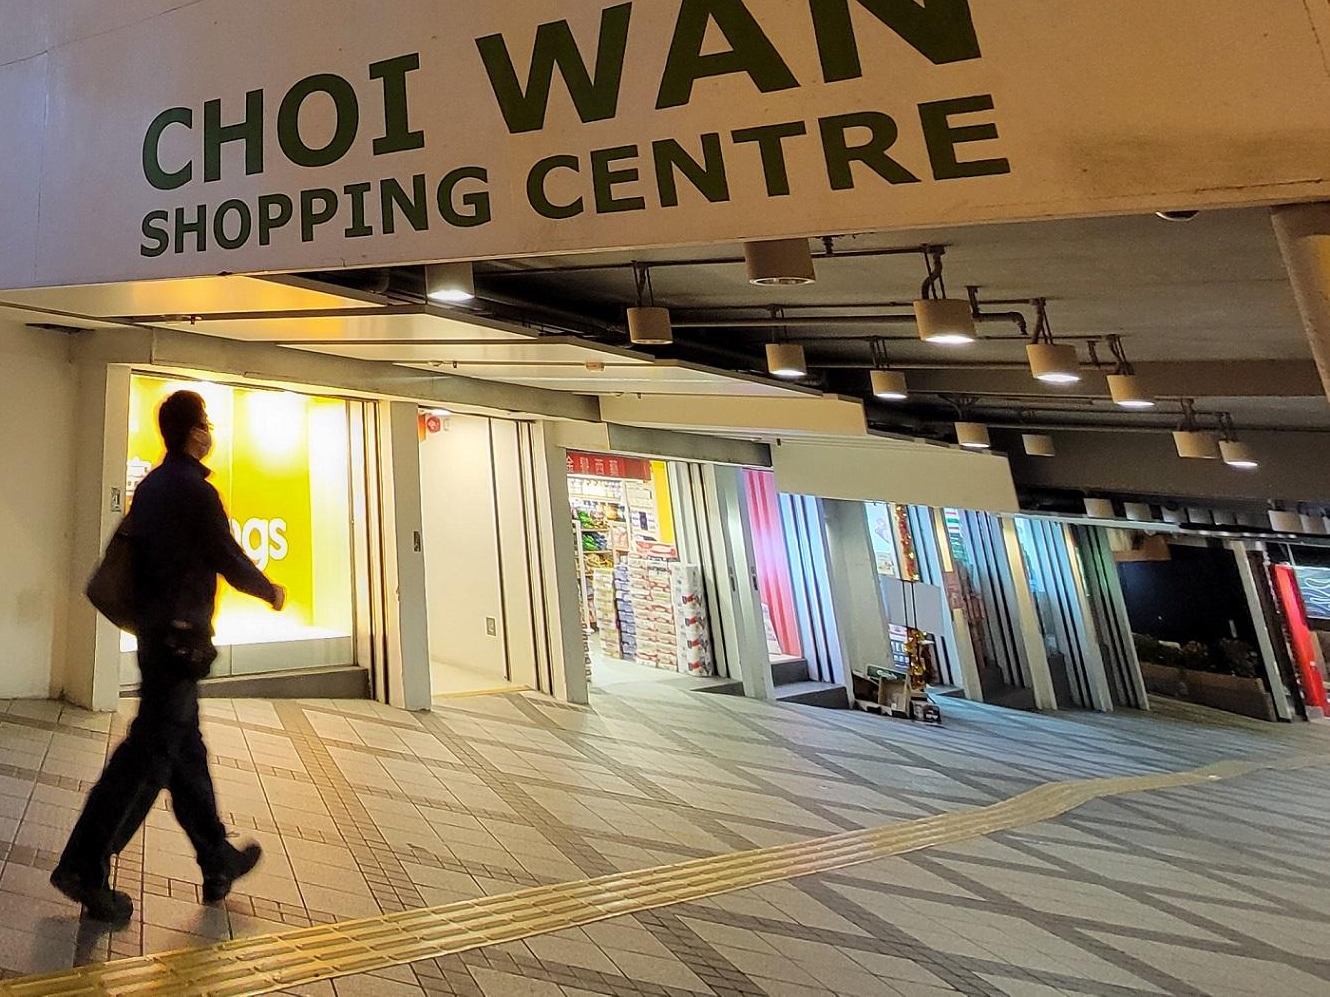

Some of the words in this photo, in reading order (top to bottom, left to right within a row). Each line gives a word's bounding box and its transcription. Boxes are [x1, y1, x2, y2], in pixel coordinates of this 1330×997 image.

[140, 166, 491, 258] SHOPPING
[526, 94, 1011, 219] CENTRE
[141, 52, 425, 191] CHOI
[230, 517, 288, 570] gs
